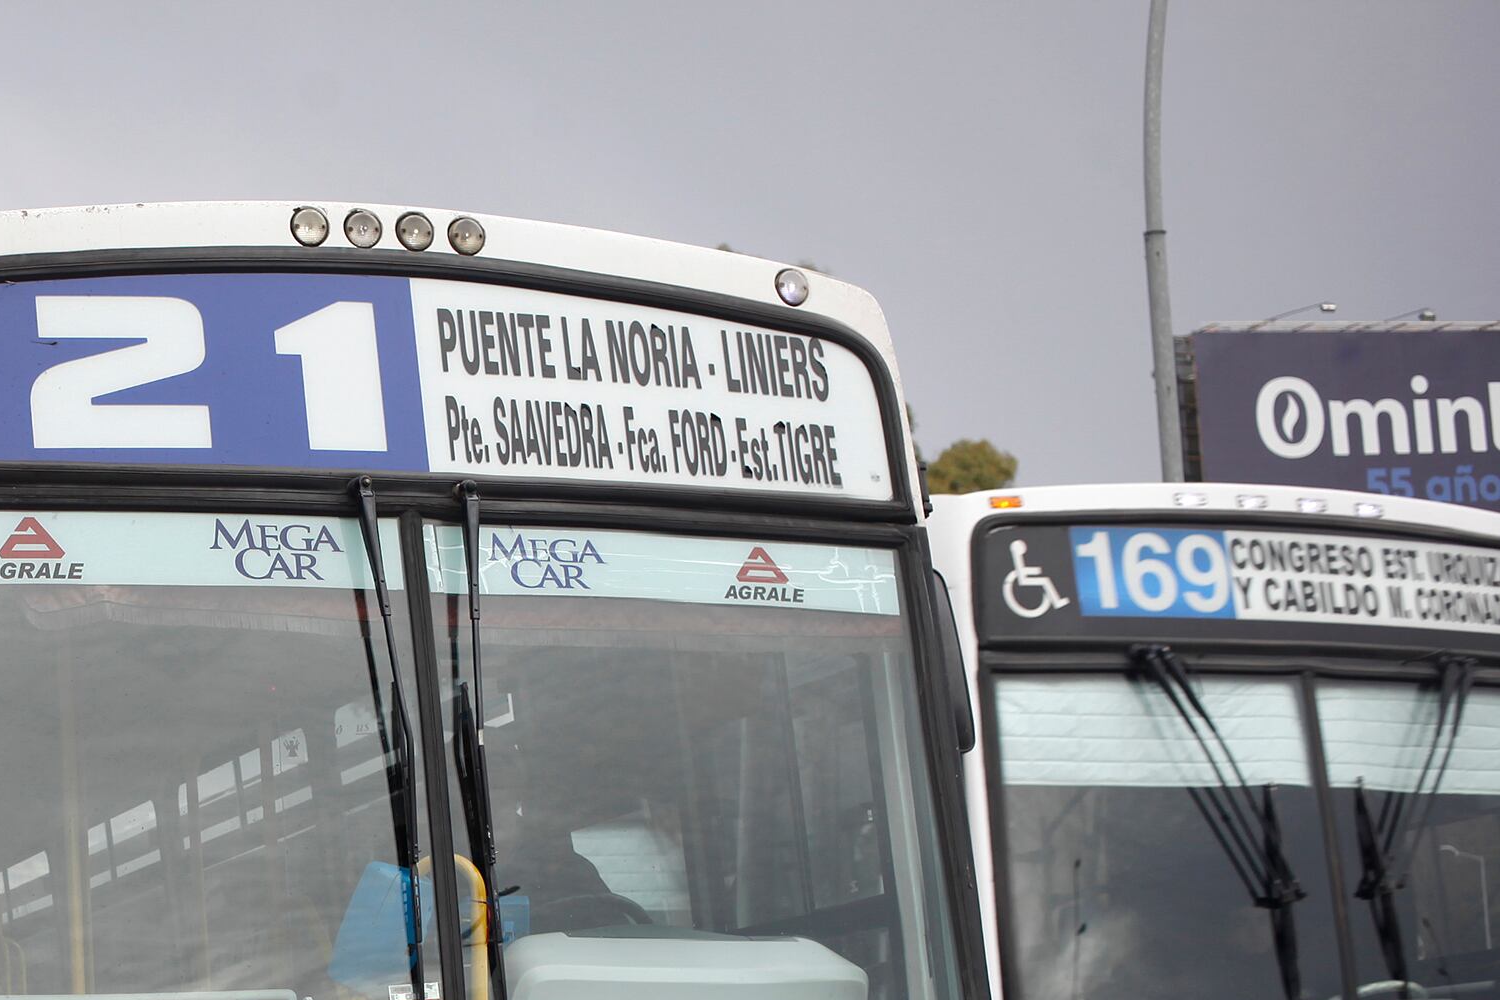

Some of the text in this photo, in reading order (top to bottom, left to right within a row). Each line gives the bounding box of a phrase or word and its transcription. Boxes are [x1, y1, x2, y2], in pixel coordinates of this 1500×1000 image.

[30, 295, 388, 453] 21
[436, 308, 556, 378] PUENTE
[561, 316, 602, 382] LA
[605, 319, 702, 389] NORIA
[721, 329, 829, 402] LINIERS
[444, 395, 490, 464] Pte.
[493, 396, 614, 469] SAAVEDRA
[1365, 466, 1415, 498] 55
[209, 518, 344, 553] MEGA
[487, 532, 608, 565] MEGA
[235, 547, 324, 581] CAR
[511, 558, 592, 590] CAR
[1075, 531, 1230, 614] 169
[1230, 538, 1374, 578] CONGRESO
[1382, 548, 1425, 581] EST.
[724, 584, 805, 604] AGRALE
[1235, 576, 1252, 609] Y
[1265, 577, 1379, 617] CABILDO
